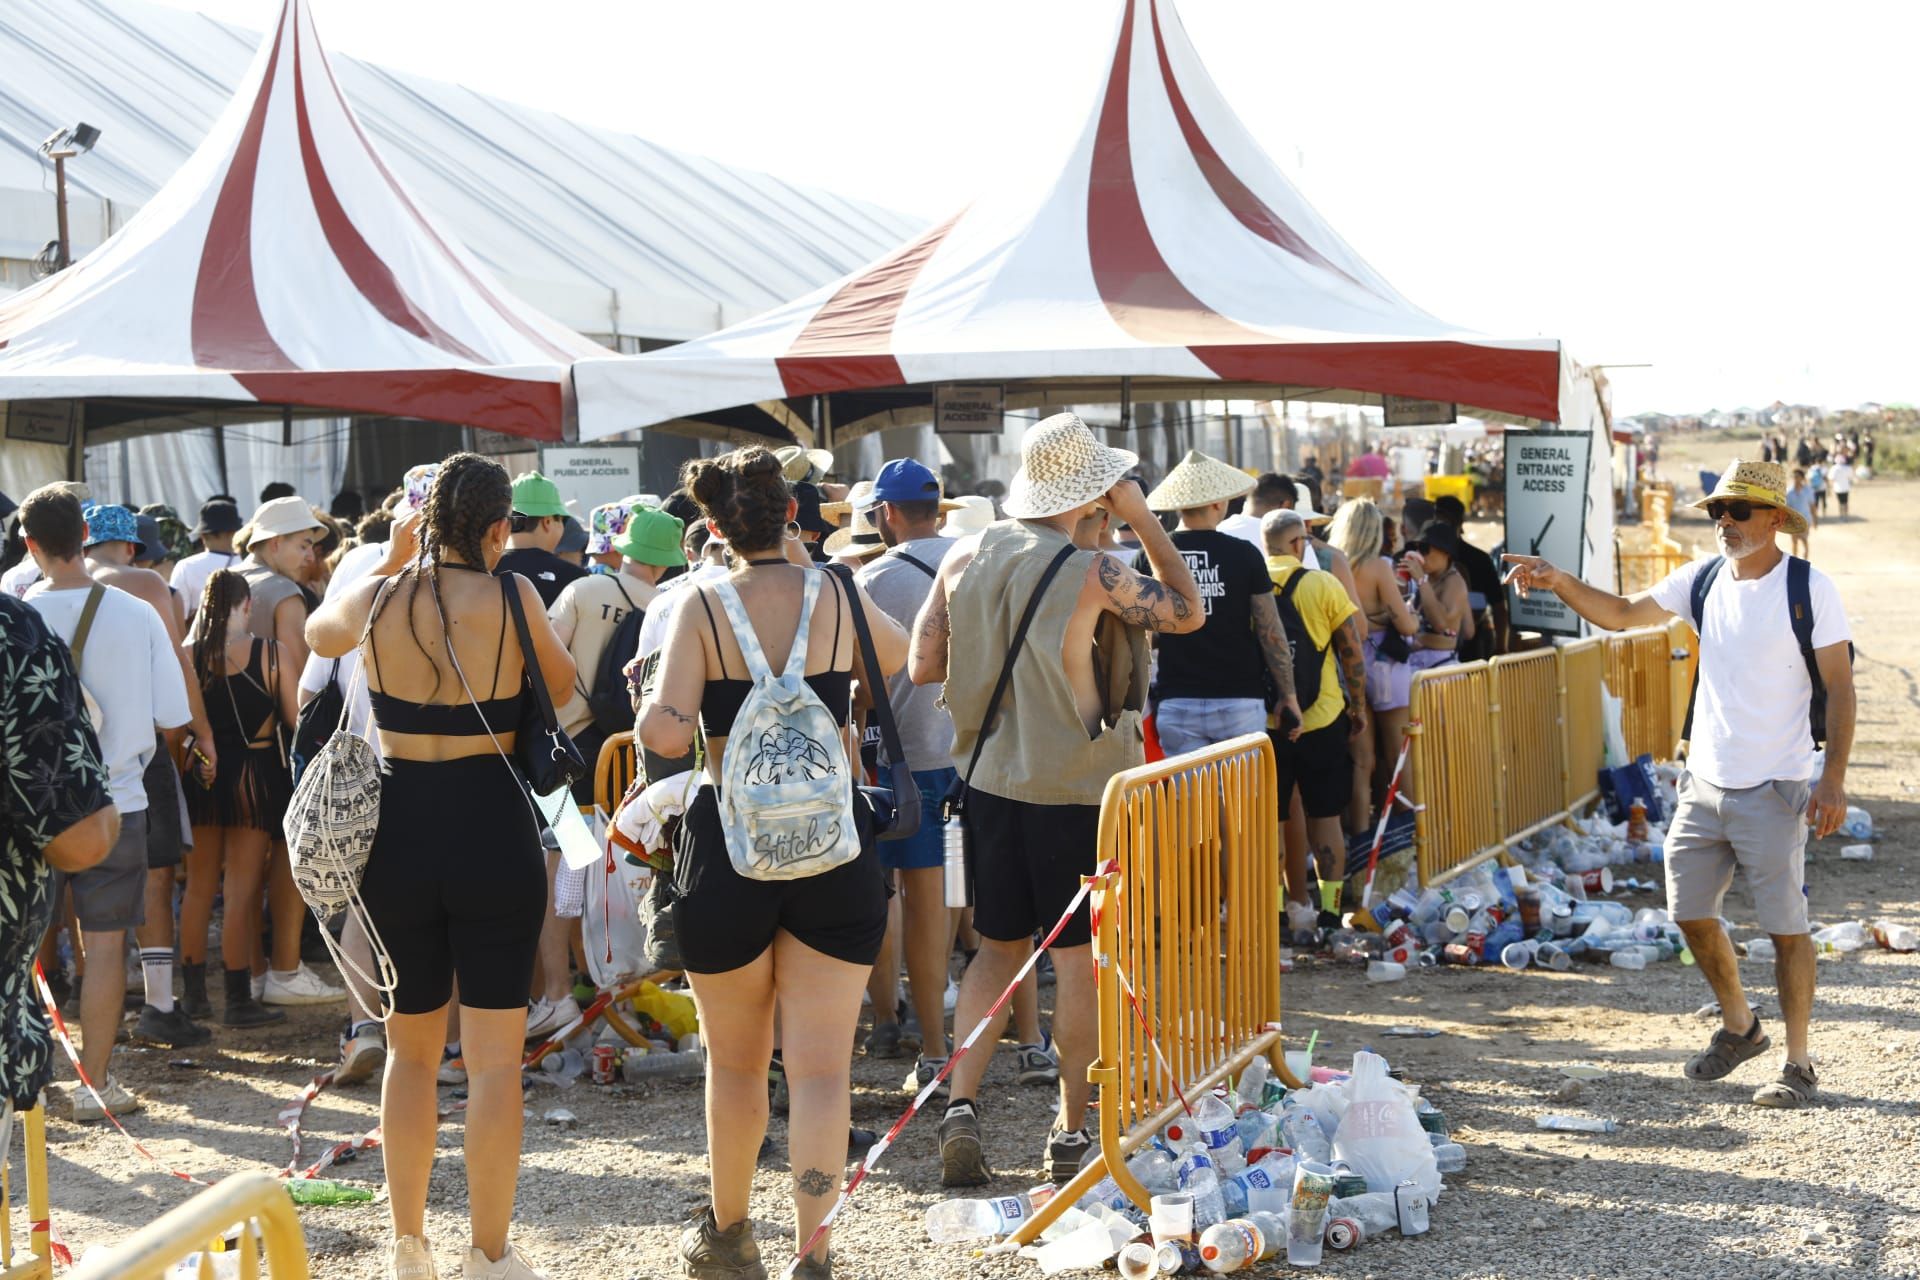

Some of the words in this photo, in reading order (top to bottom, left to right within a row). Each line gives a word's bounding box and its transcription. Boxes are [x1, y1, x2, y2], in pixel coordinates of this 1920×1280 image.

[1520, 447, 1571, 461] GENERAL
[569, 458, 613, 467] GENERAL
[553, 468, 589, 476] PUBLIC
[591, 467, 630, 476] ACCESS
[1516, 463, 1574, 477] ENTRANCE
[1522, 479, 1566, 493] ACCESS
[1192, 564, 1220, 583] EVIVÍ
[1198, 582, 1226, 597] GROS
[752, 817, 841, 872] Stitch
